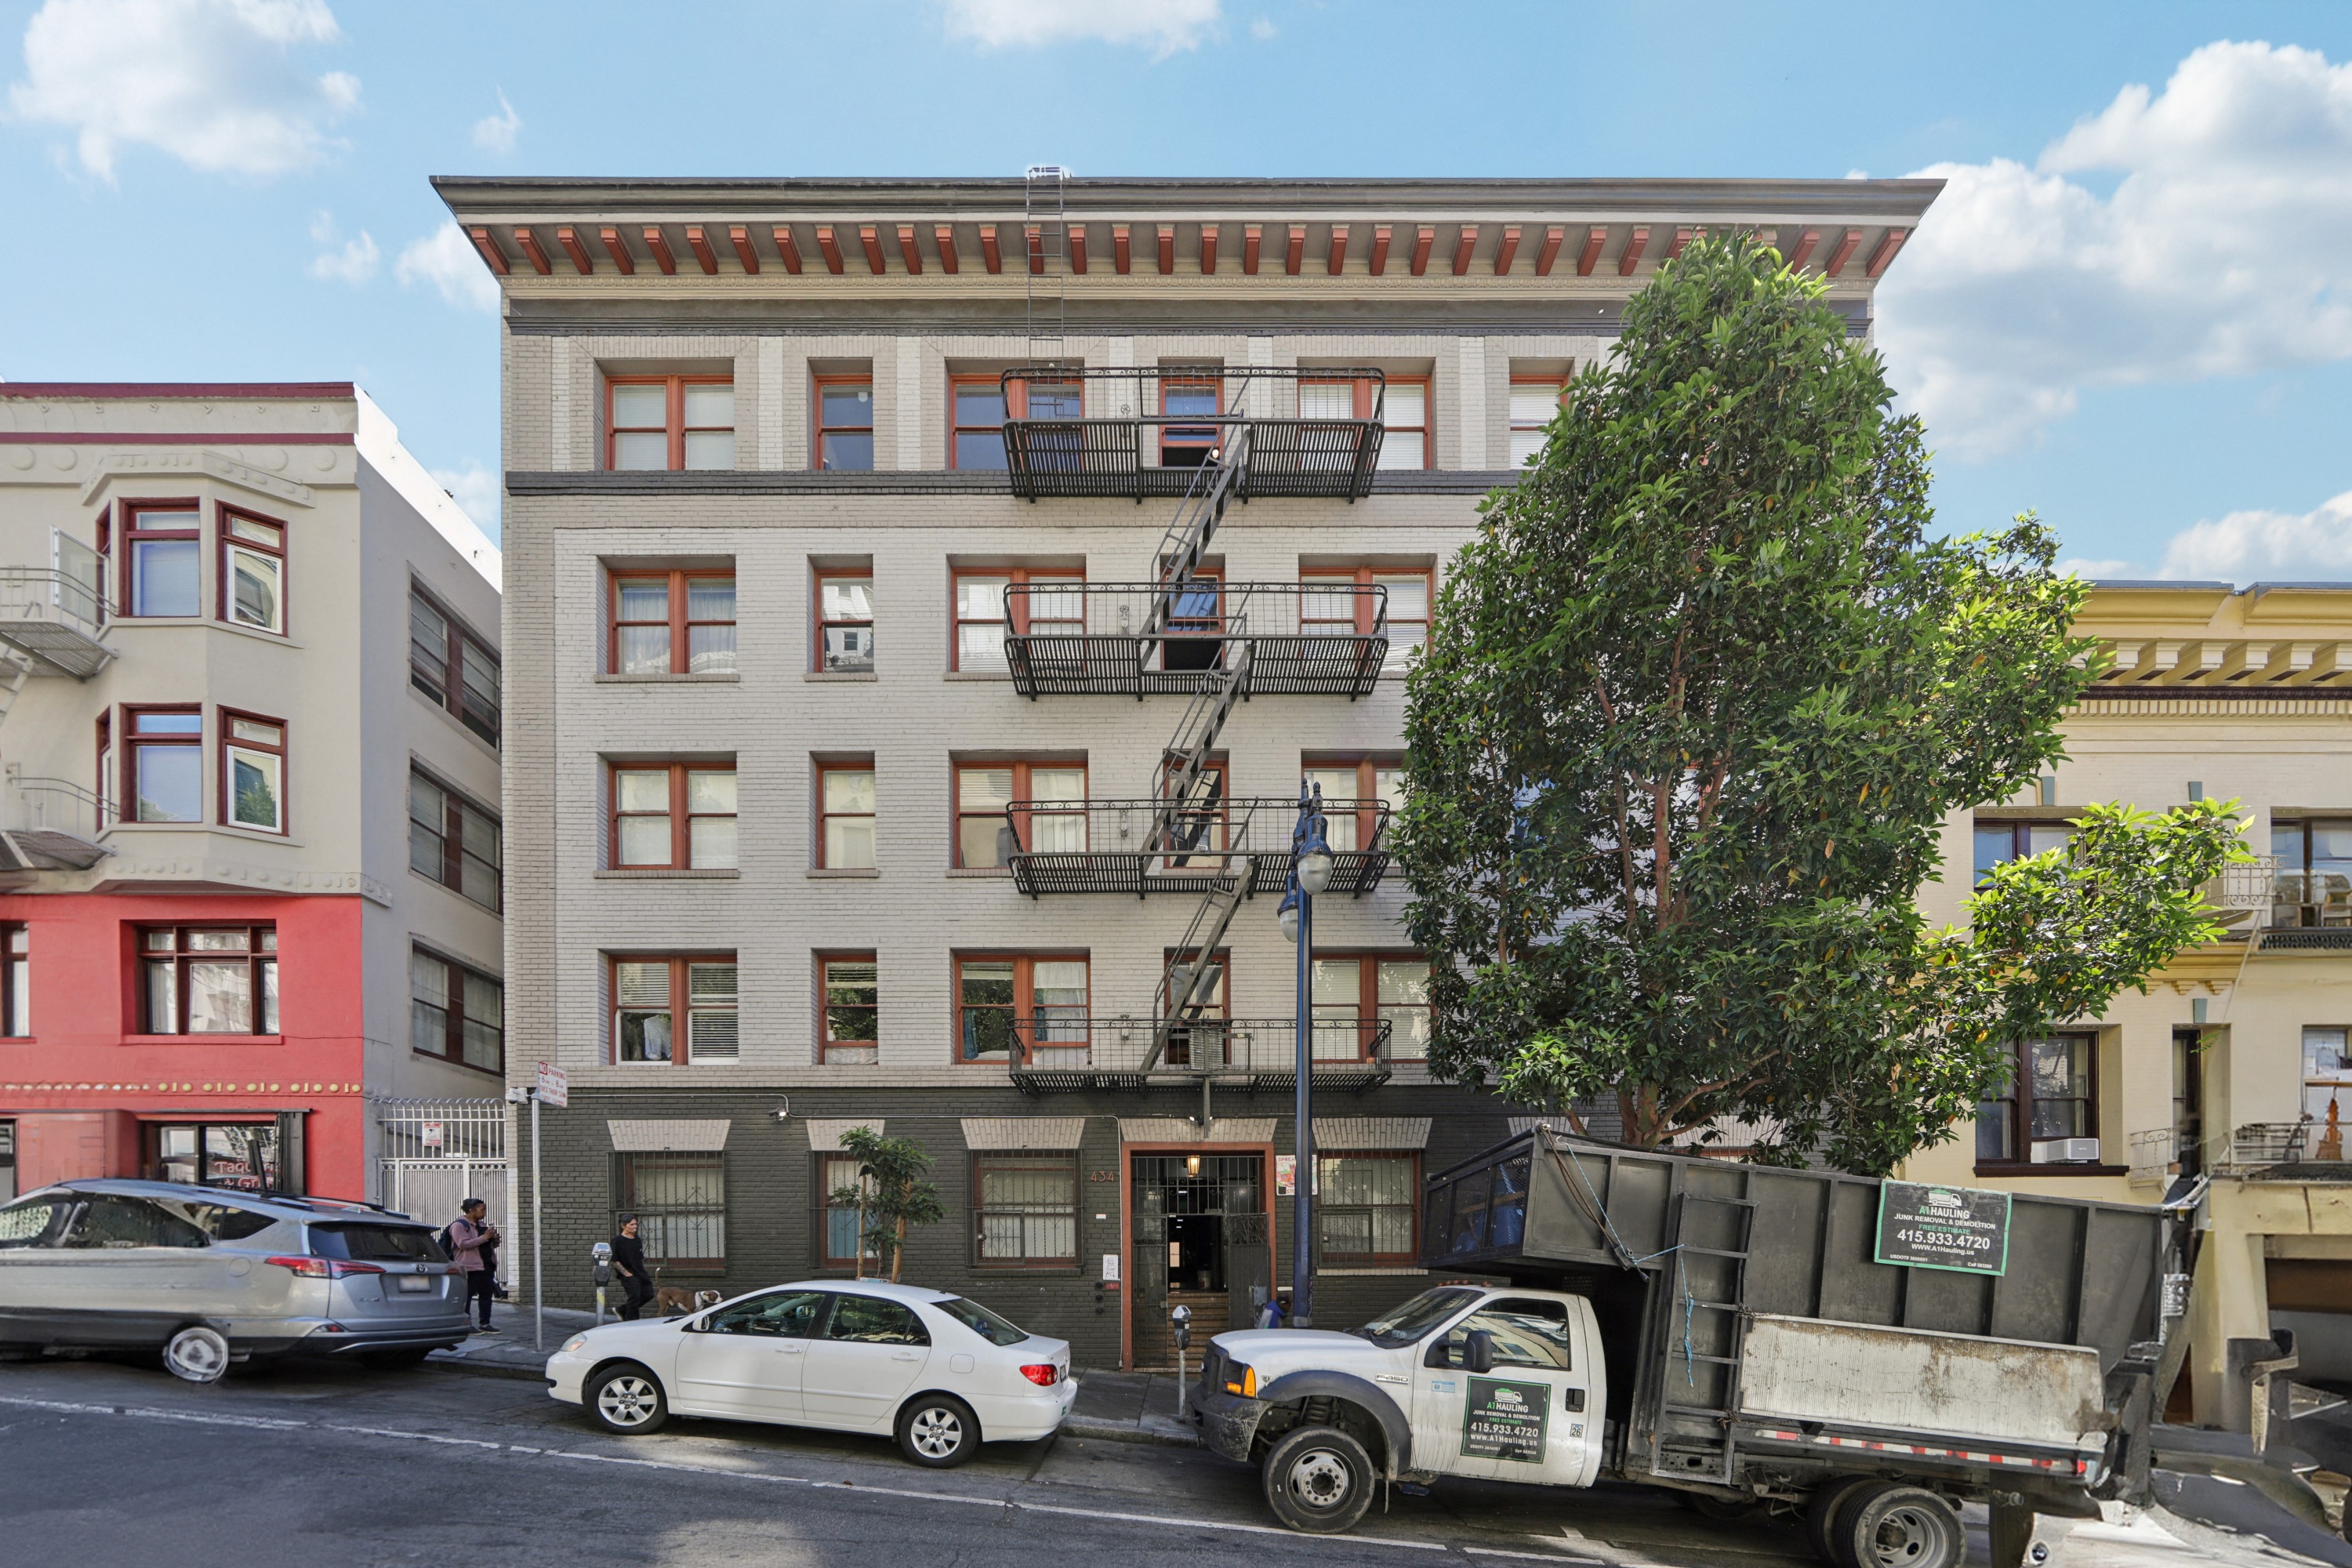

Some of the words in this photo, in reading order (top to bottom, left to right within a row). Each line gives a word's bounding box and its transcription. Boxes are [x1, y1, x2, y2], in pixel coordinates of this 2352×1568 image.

[539, 1062, 547, 1074] NO
[549, 1068, 566, 1080] PARKING
[1091, 1171, 1114, 1182] 434
[1915, 1215, 1947, 1225] REMOVAL
[1955, 1220, 1995, 1229] DEMOLITION
[1938, 1225, 1971, 1235] ESTIMATE
[1897, 1229, 1991, 1249] 415.933.4720
[1470, 1422, 1539, 1438] 415.933.4720
[1571, 1427, 1581, 1437] 26
